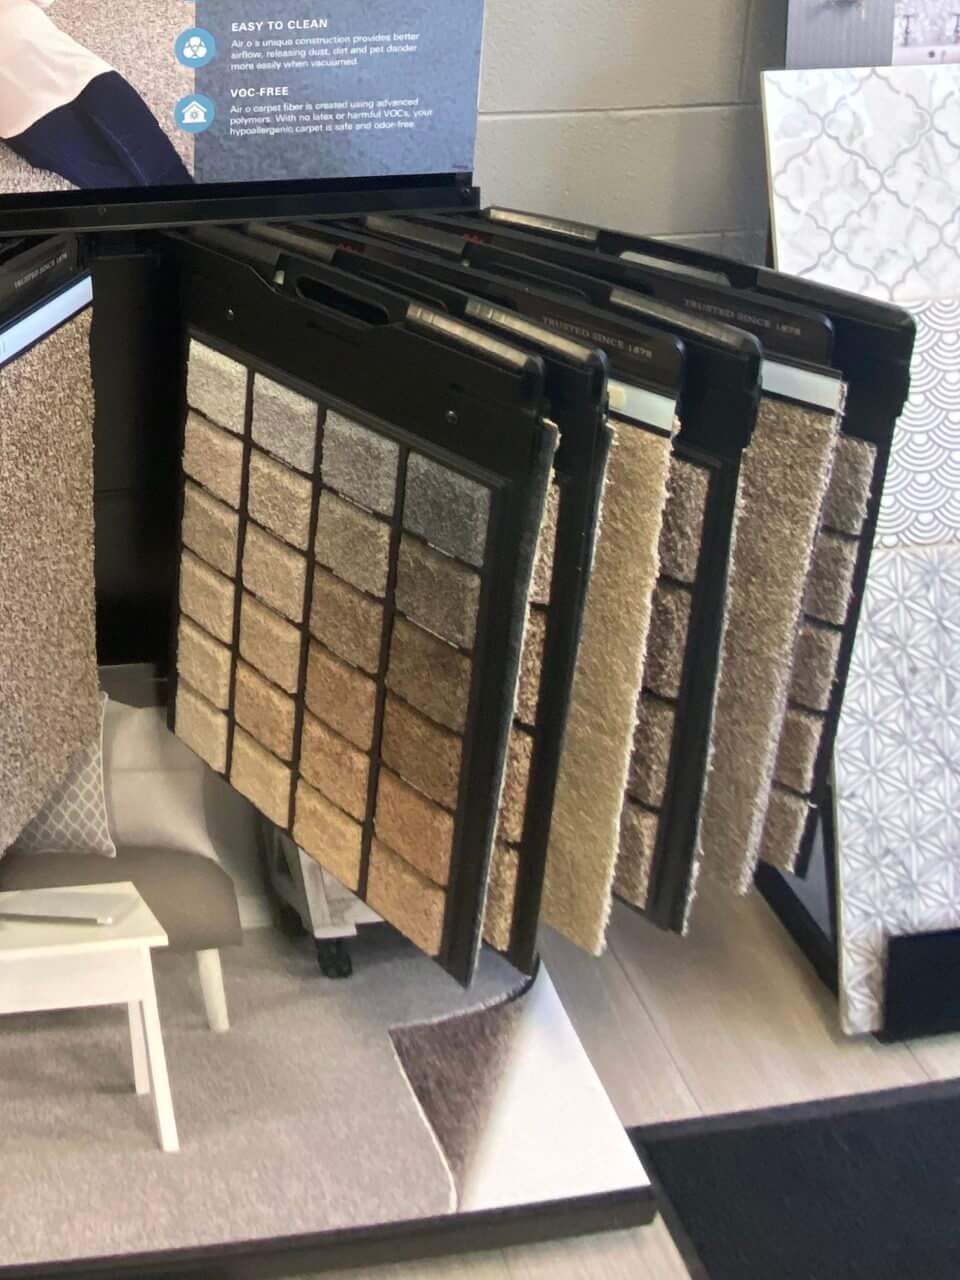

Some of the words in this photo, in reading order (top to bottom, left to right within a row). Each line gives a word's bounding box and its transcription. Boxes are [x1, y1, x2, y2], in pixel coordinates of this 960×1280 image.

[231, 22, 264, 33] EASY
[267, 20, 284, 31] TO
[287, 18, 329, 30] CLEAN
[262, 37, 294, 49] unique
[295, 35, 351, 45] construction
[352, 33, 391, 44] provides
[393, 32, 420, 42] better
[266, 48, 306, 59] releasing
[308, 47, 331, 57] dust,
[332, 46, 349, 56] dirt
[350, 45, 368, 55] and
[369, 44, 385, 56] pet
[386, 43, 418, 53] dander
[230, 63, 254, 71] more
[255, 60, 281, 71] easily
[282, 60, 309, 69] when
[230, 86, 289, 98] VOC-FREE
[253, 103, 281, 115] carpet
[282, 101, 304, 112] fiber
[315, 100, 348, 111] created
[350, 99, 375, 110] using
[376, 96, 419, 108] advanced
[274, 113, 297, 123] With
[298, 114, 312, 122] no
[312, 111, 334, 122] latex
[347, 110, 381, 120] harmful
[412, 107, 434, 119] your
[230, 124, 295, 137] hypoallergenic
[295, 123, 324, 135] carpet
[334, 121, 354, 131] safe
[355, 121, 373, 131] and
